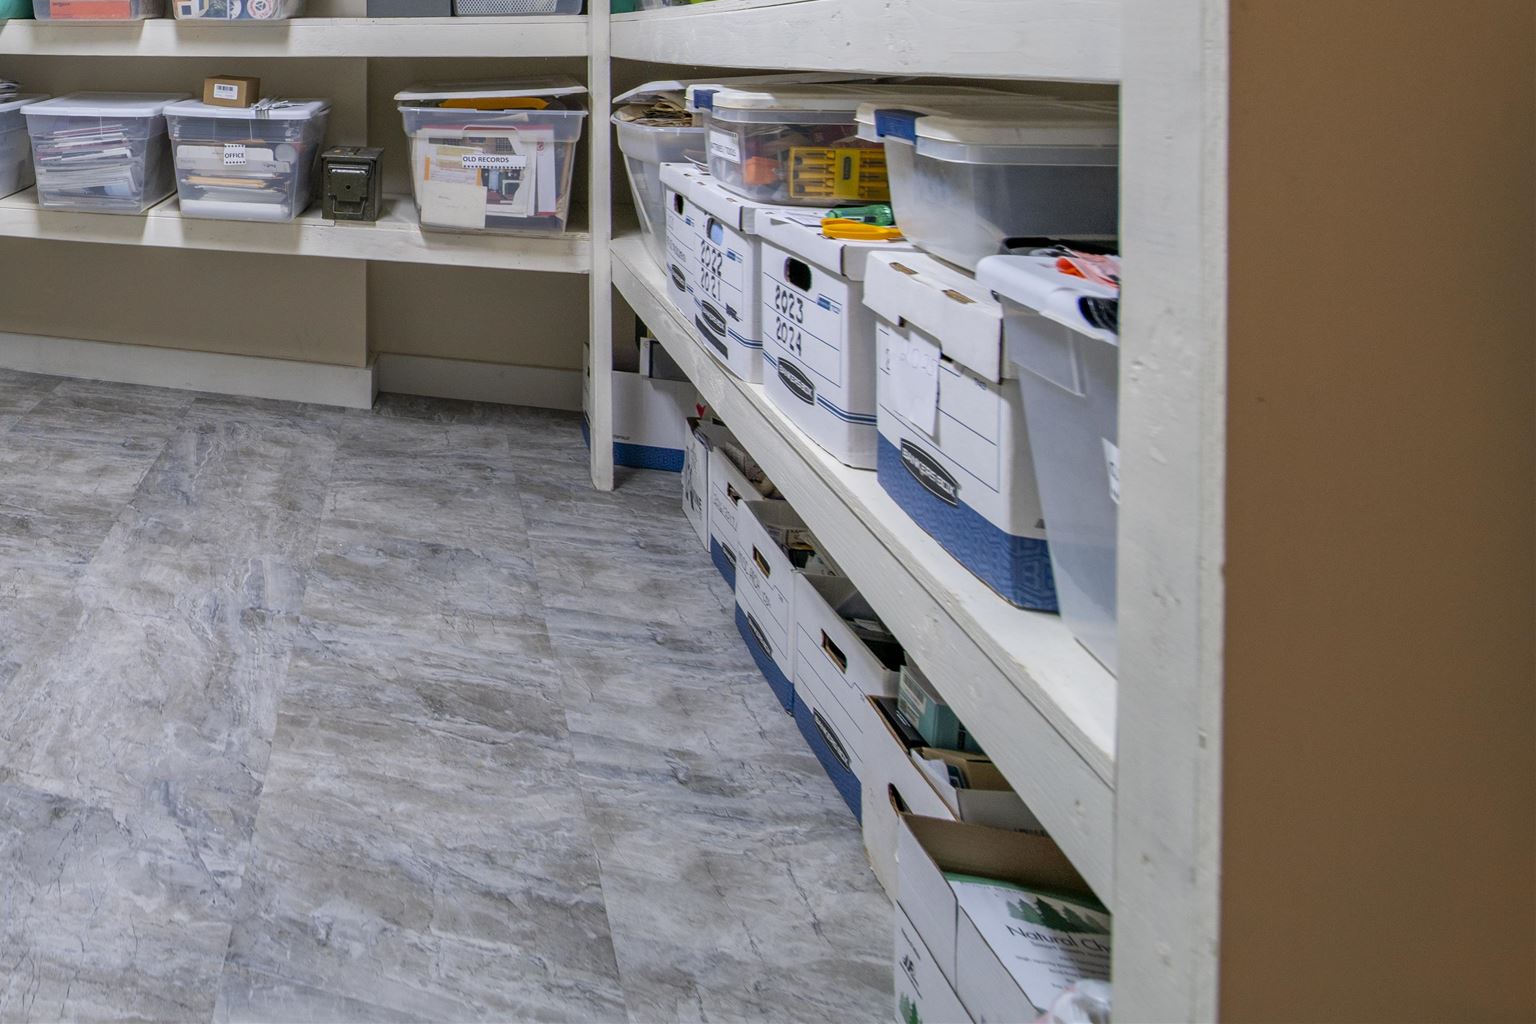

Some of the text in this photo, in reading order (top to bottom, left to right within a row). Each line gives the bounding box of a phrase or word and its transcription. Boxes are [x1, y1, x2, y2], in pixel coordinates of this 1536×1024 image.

[700, 239, 723, 277] 2022
[700, 267, 721, 301] 2021
[775, 285, 804, 324] 2023
[776, 316, 802, 357] 2024
[1005, 924, 1079, 948] Natural
